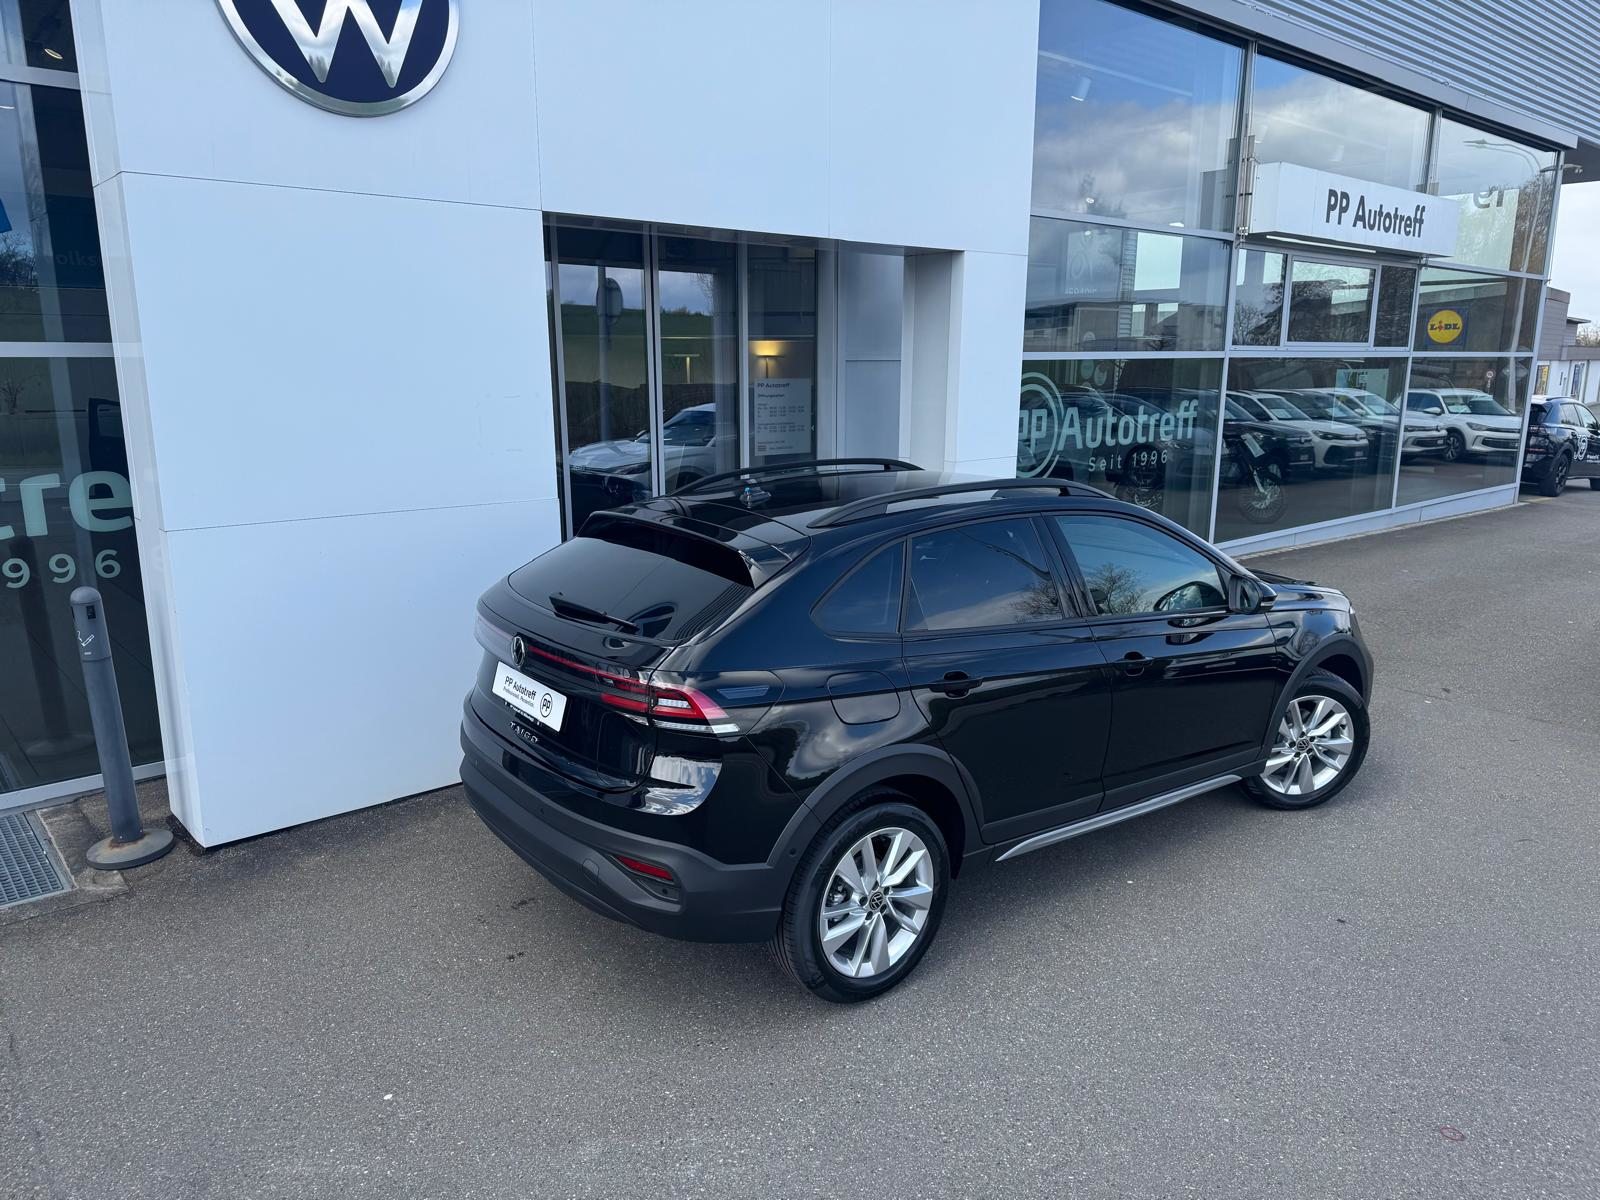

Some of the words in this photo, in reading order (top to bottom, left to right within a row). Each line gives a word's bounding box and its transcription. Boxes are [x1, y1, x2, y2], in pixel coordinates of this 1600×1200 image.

[1326, 189, 1350, 225] PP
[1352, 195, 1426, 238] Autotreff
[1057, 399, 1198, 451] Autotreff
[1088, 454, 1123, 472] seit
[1132, 449, 1168, 468] 1996
[505, 676, 513, 686] PP
[513, 682, 537, 700] Autotreff
